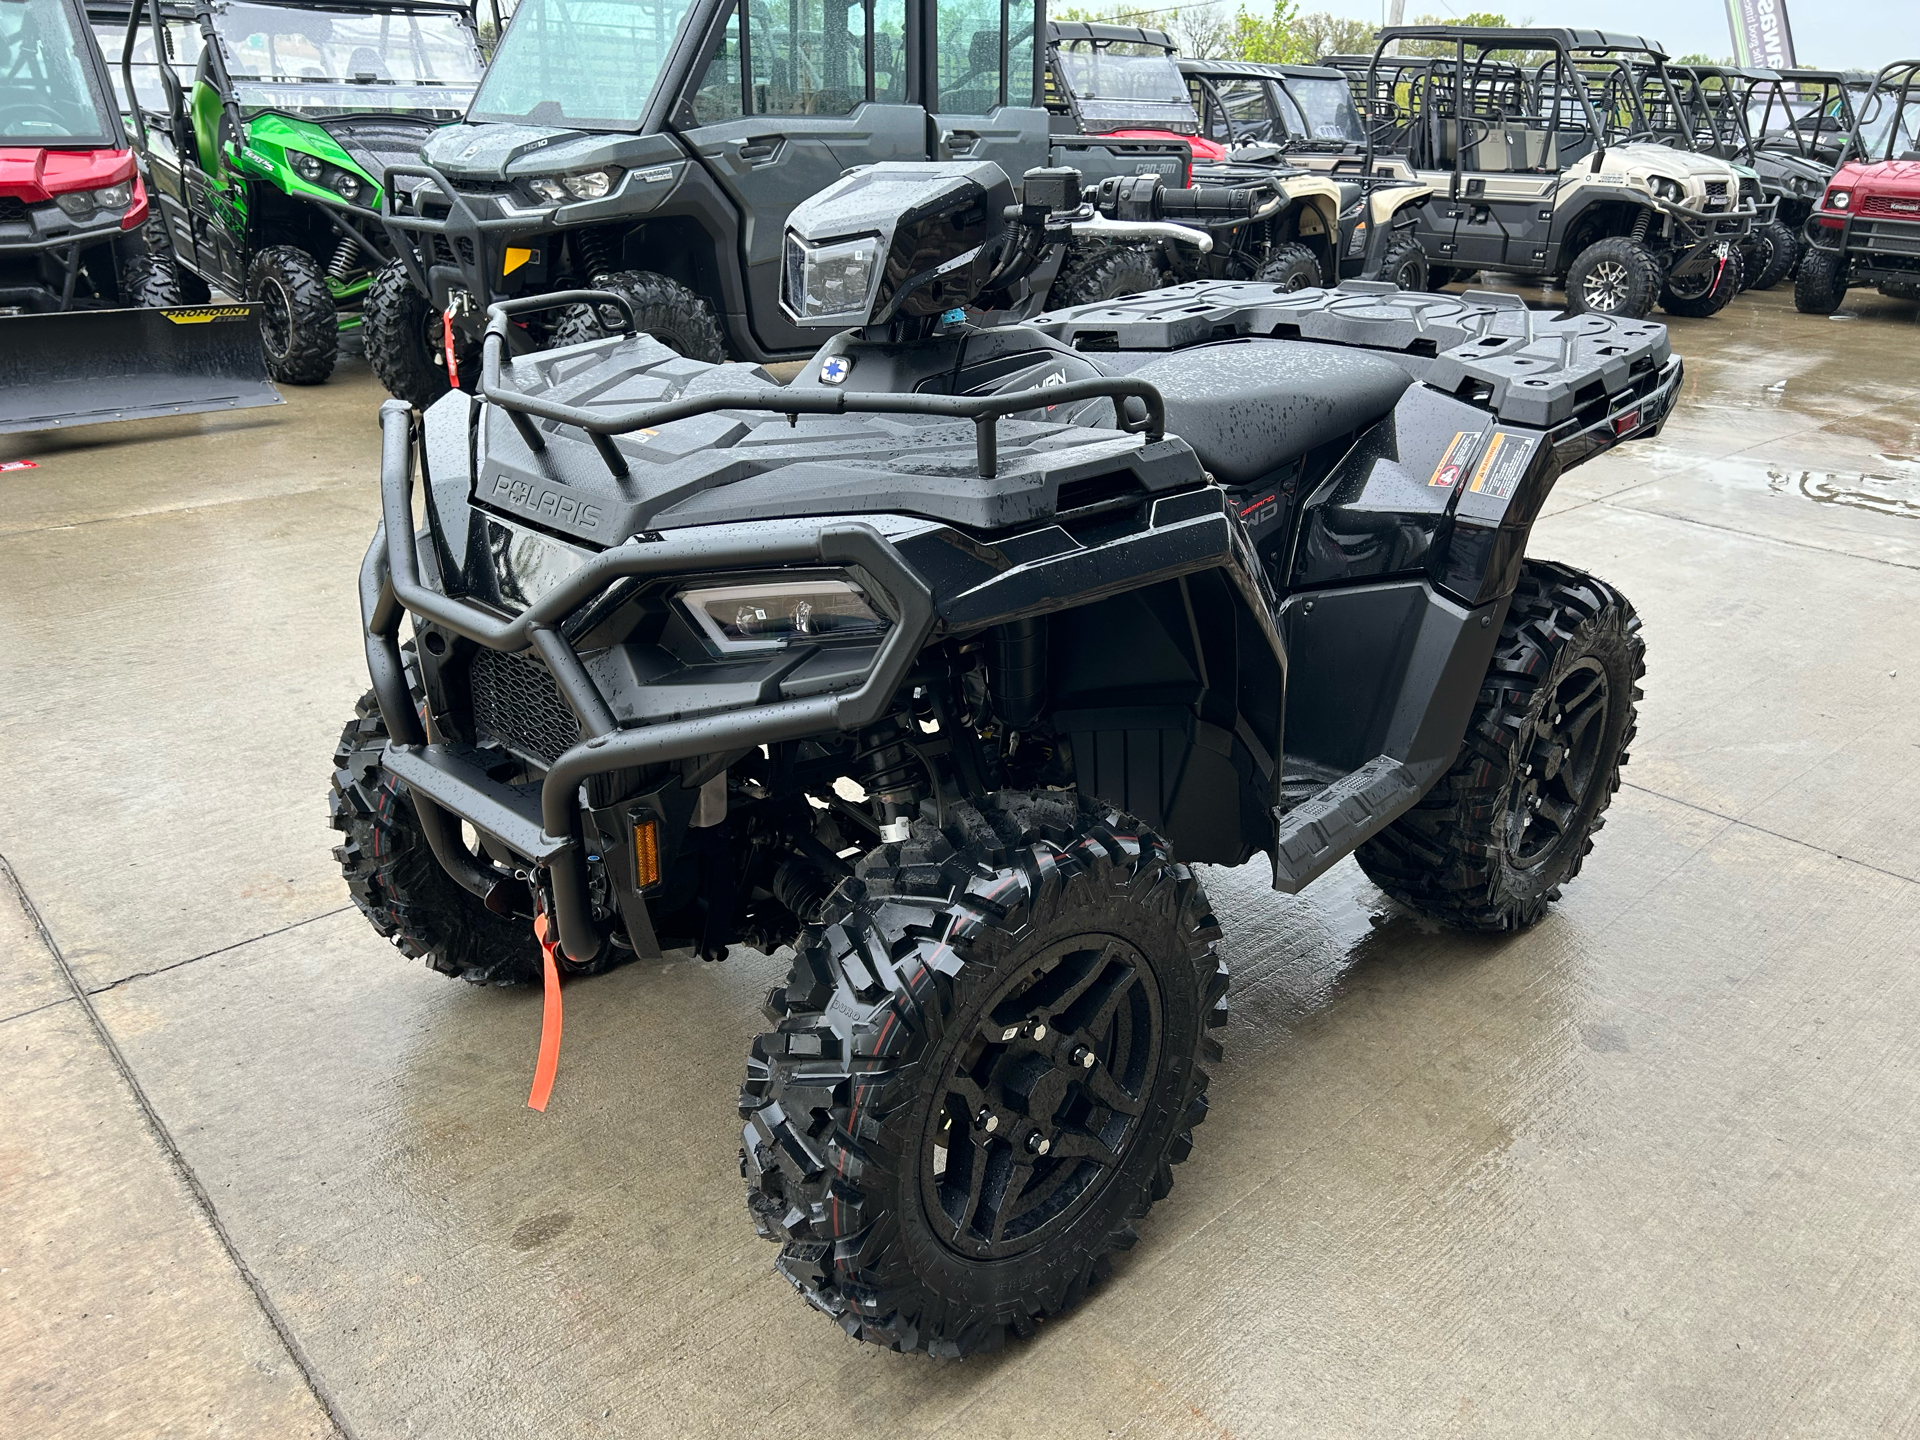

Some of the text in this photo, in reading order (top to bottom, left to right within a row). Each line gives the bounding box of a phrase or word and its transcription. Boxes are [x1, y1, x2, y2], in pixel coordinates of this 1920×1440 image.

[523, 138, 549, 152] HD10
[1135, 163, 1177, 175] can-am
[165, 307, 250, 318] PROMOUNT
[1481, 446, 1497, 471] WARNING
[491, 474, 603, 532] POLARIS
[1240, 494, 1276, 517] DEMAND
[832, 1000, 861, 1021] DURO
